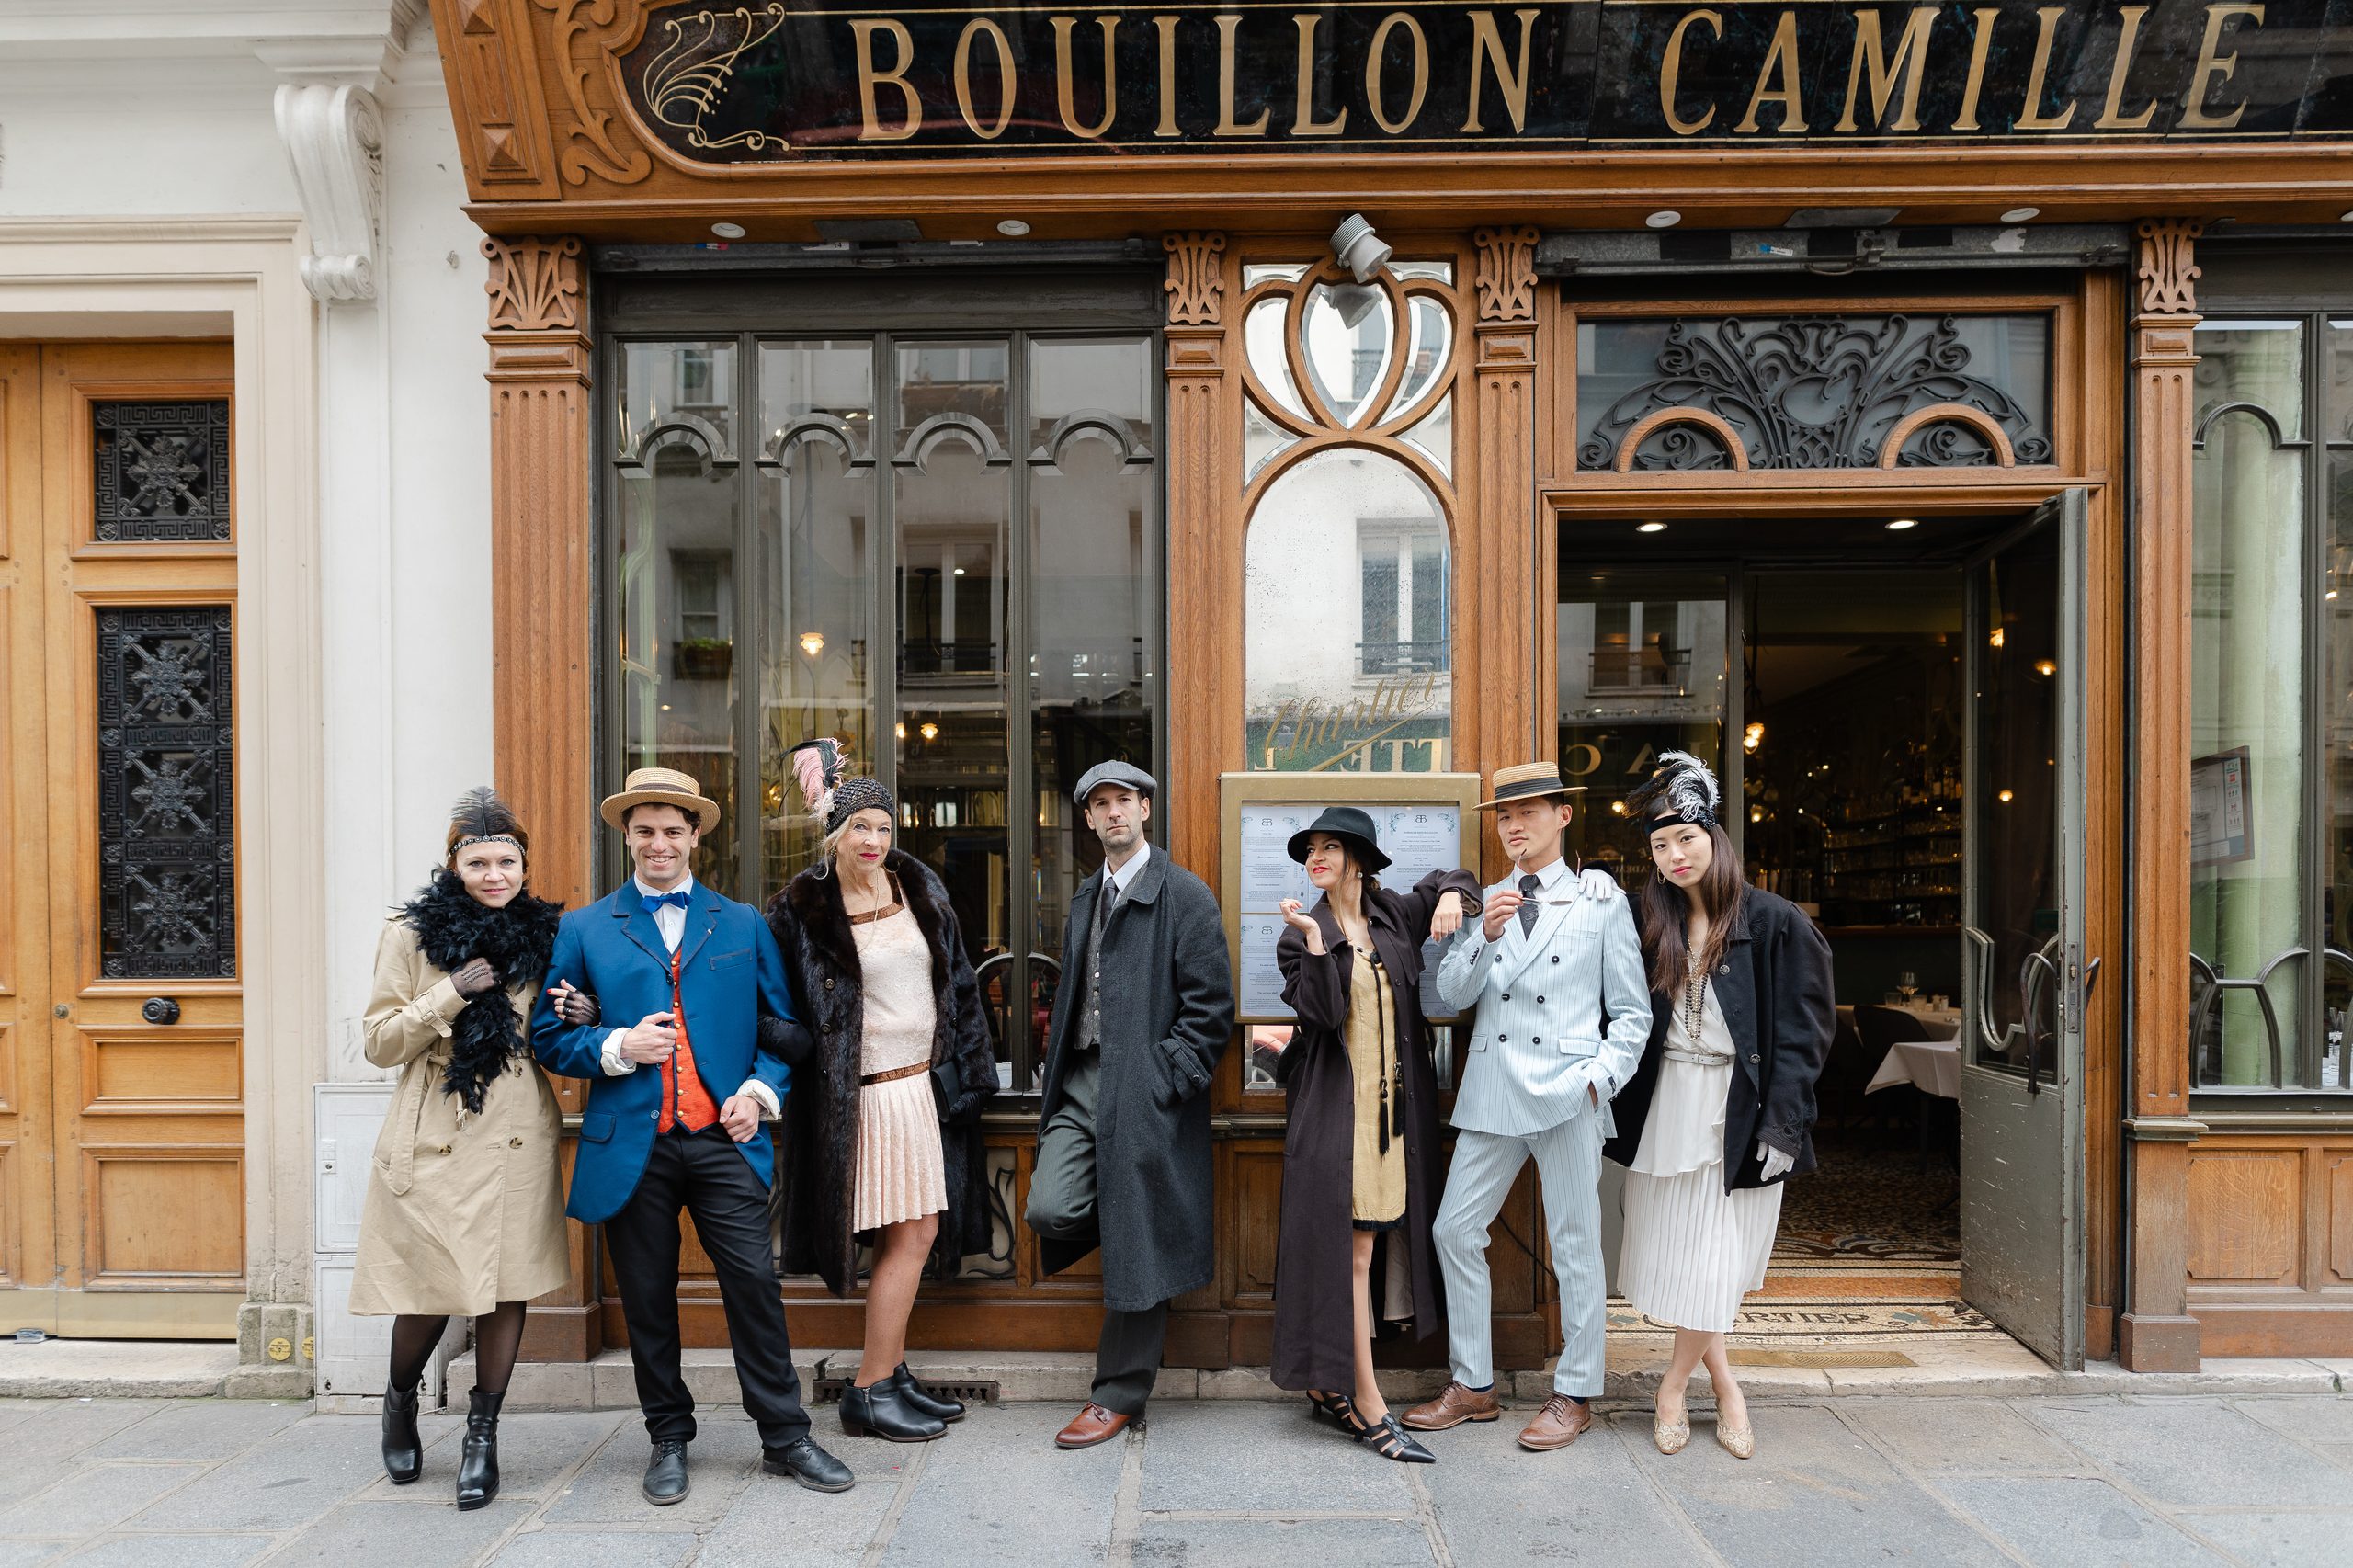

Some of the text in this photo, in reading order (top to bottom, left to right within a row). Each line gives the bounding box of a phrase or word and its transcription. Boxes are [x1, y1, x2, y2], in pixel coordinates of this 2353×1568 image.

[849, 4, 2267, 141] BOUILLON CAMILLE
[1265, 673, 1436, 769] Chartier
